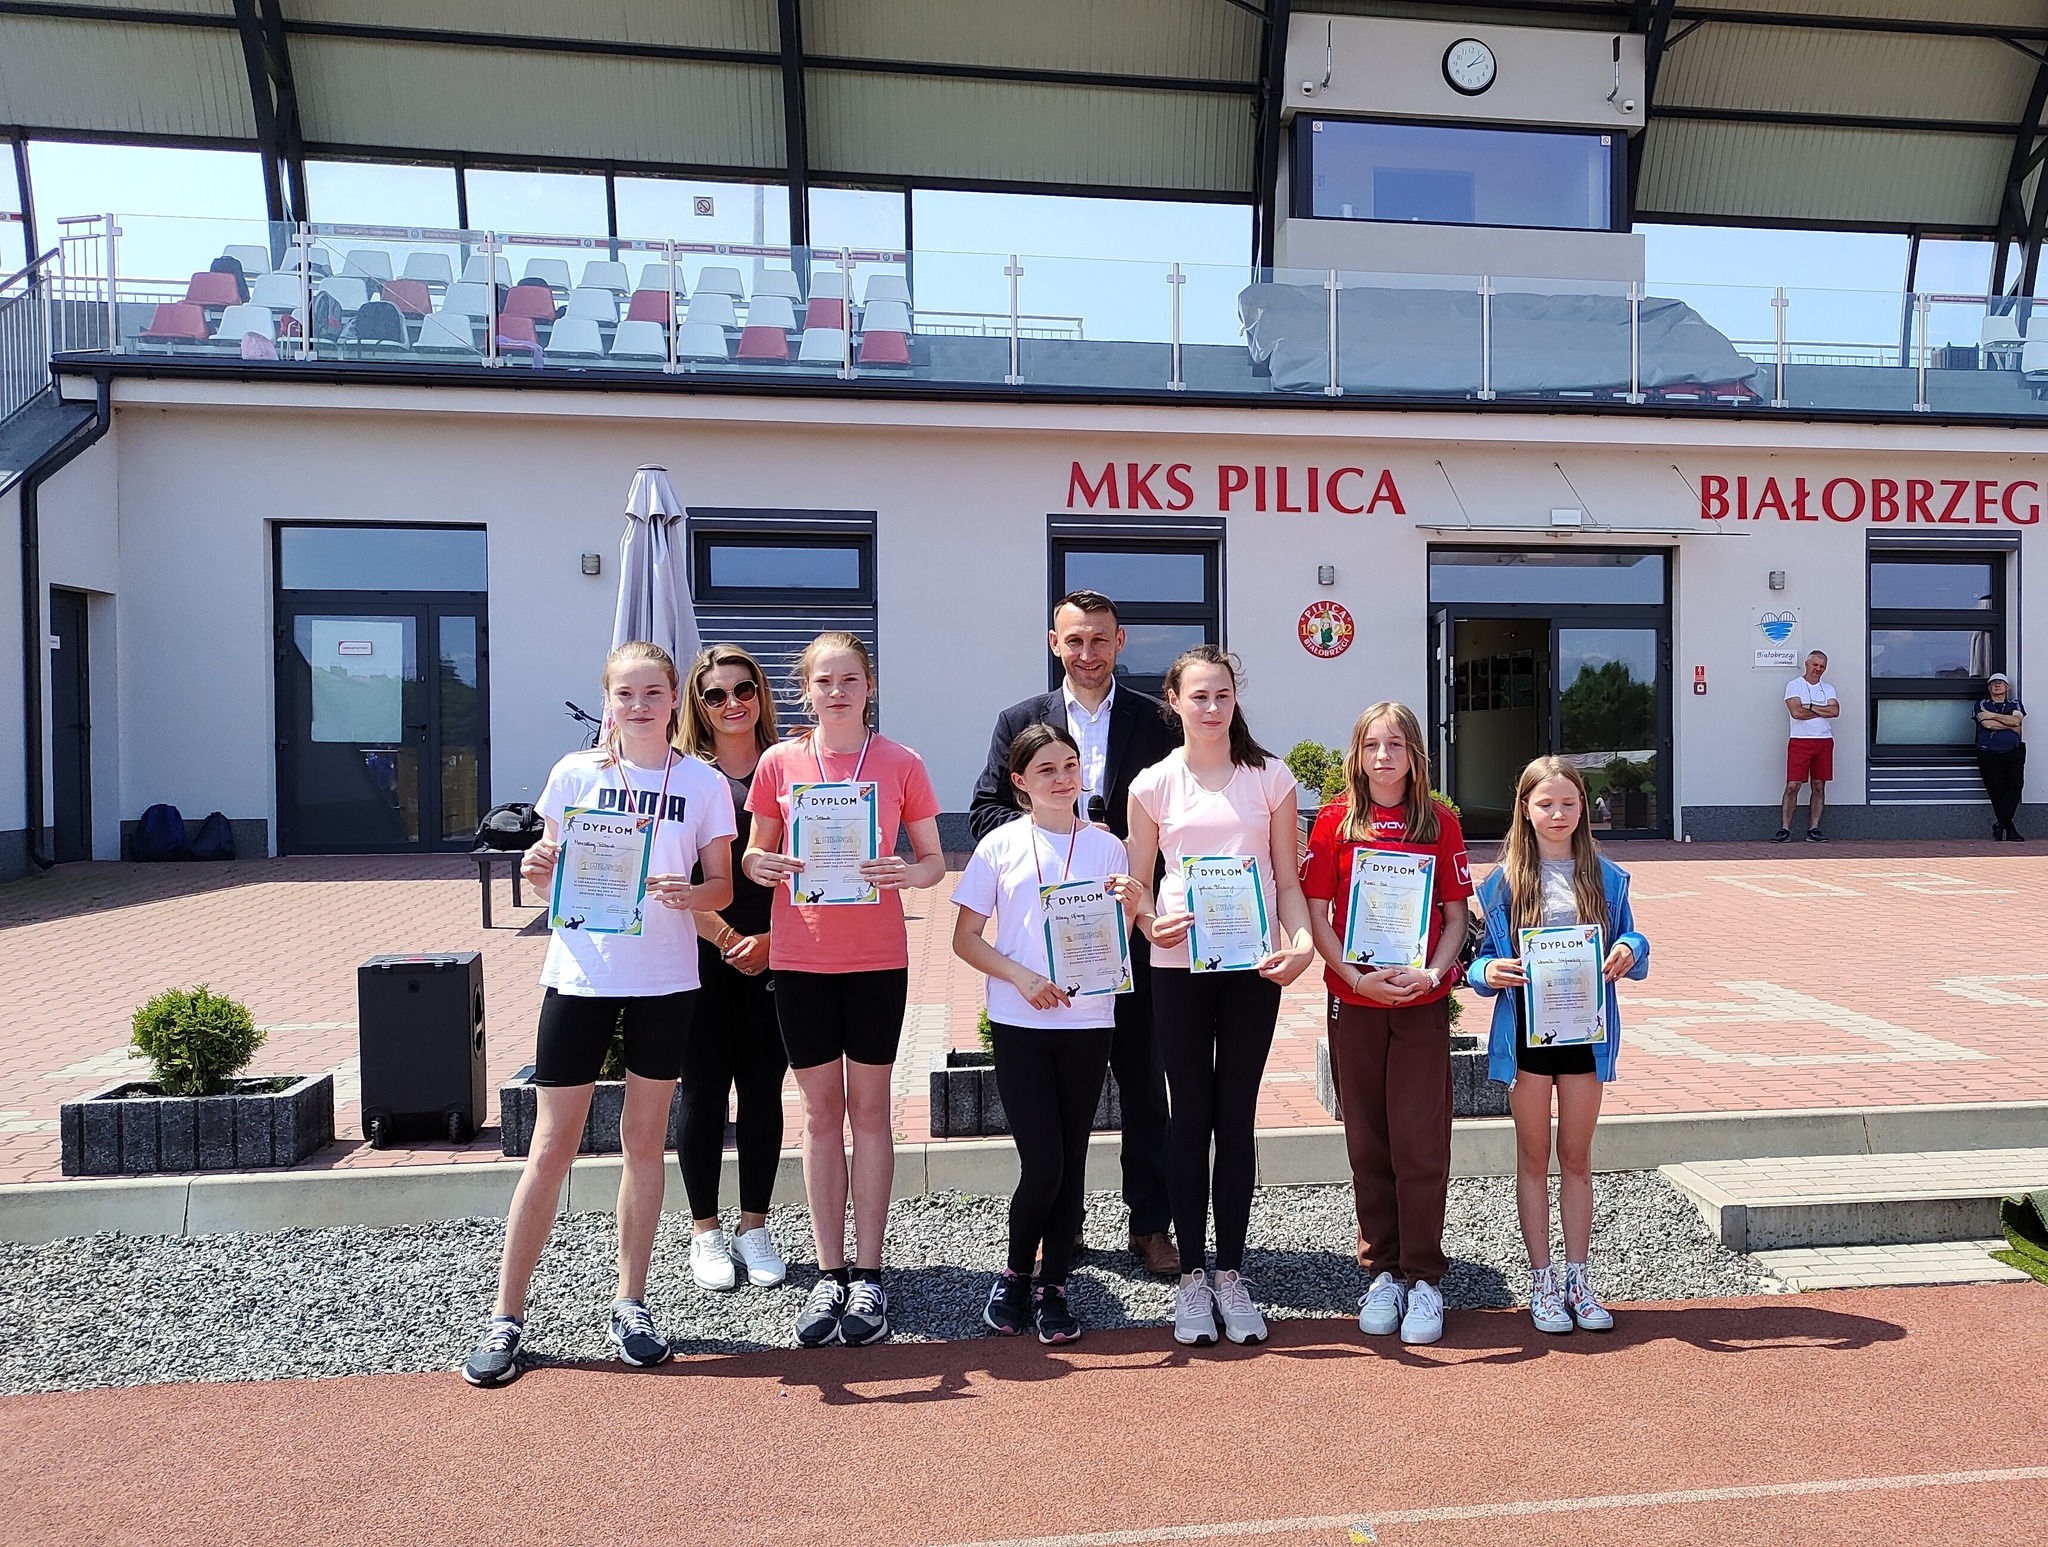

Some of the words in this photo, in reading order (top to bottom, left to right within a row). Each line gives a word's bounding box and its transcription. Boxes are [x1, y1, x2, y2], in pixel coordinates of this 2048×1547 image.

[1066, 461, 1194, 511] MKS
[1217, 464, 1407, 515] PILICA
[1700, 475, 2048, 525] BIAŁOBRZEG
[1304, 602, 1347, 619] PILICA
[1304, 638, 1349, 657] BIAŁOBRZEGI
[1756, 651, 1796, 660] Białobrzegi
[598, 788, 686, 823] PUMA
[811, 797, 857, 806] DYPLOM
[582, 822, 633, 836] DYPLOM
[1372, 864, 1415, 875] DYPLOM
[1058, 892, 1103, 906] DYPLOM
[1540, 940, 1584, 950] DYPLOM
